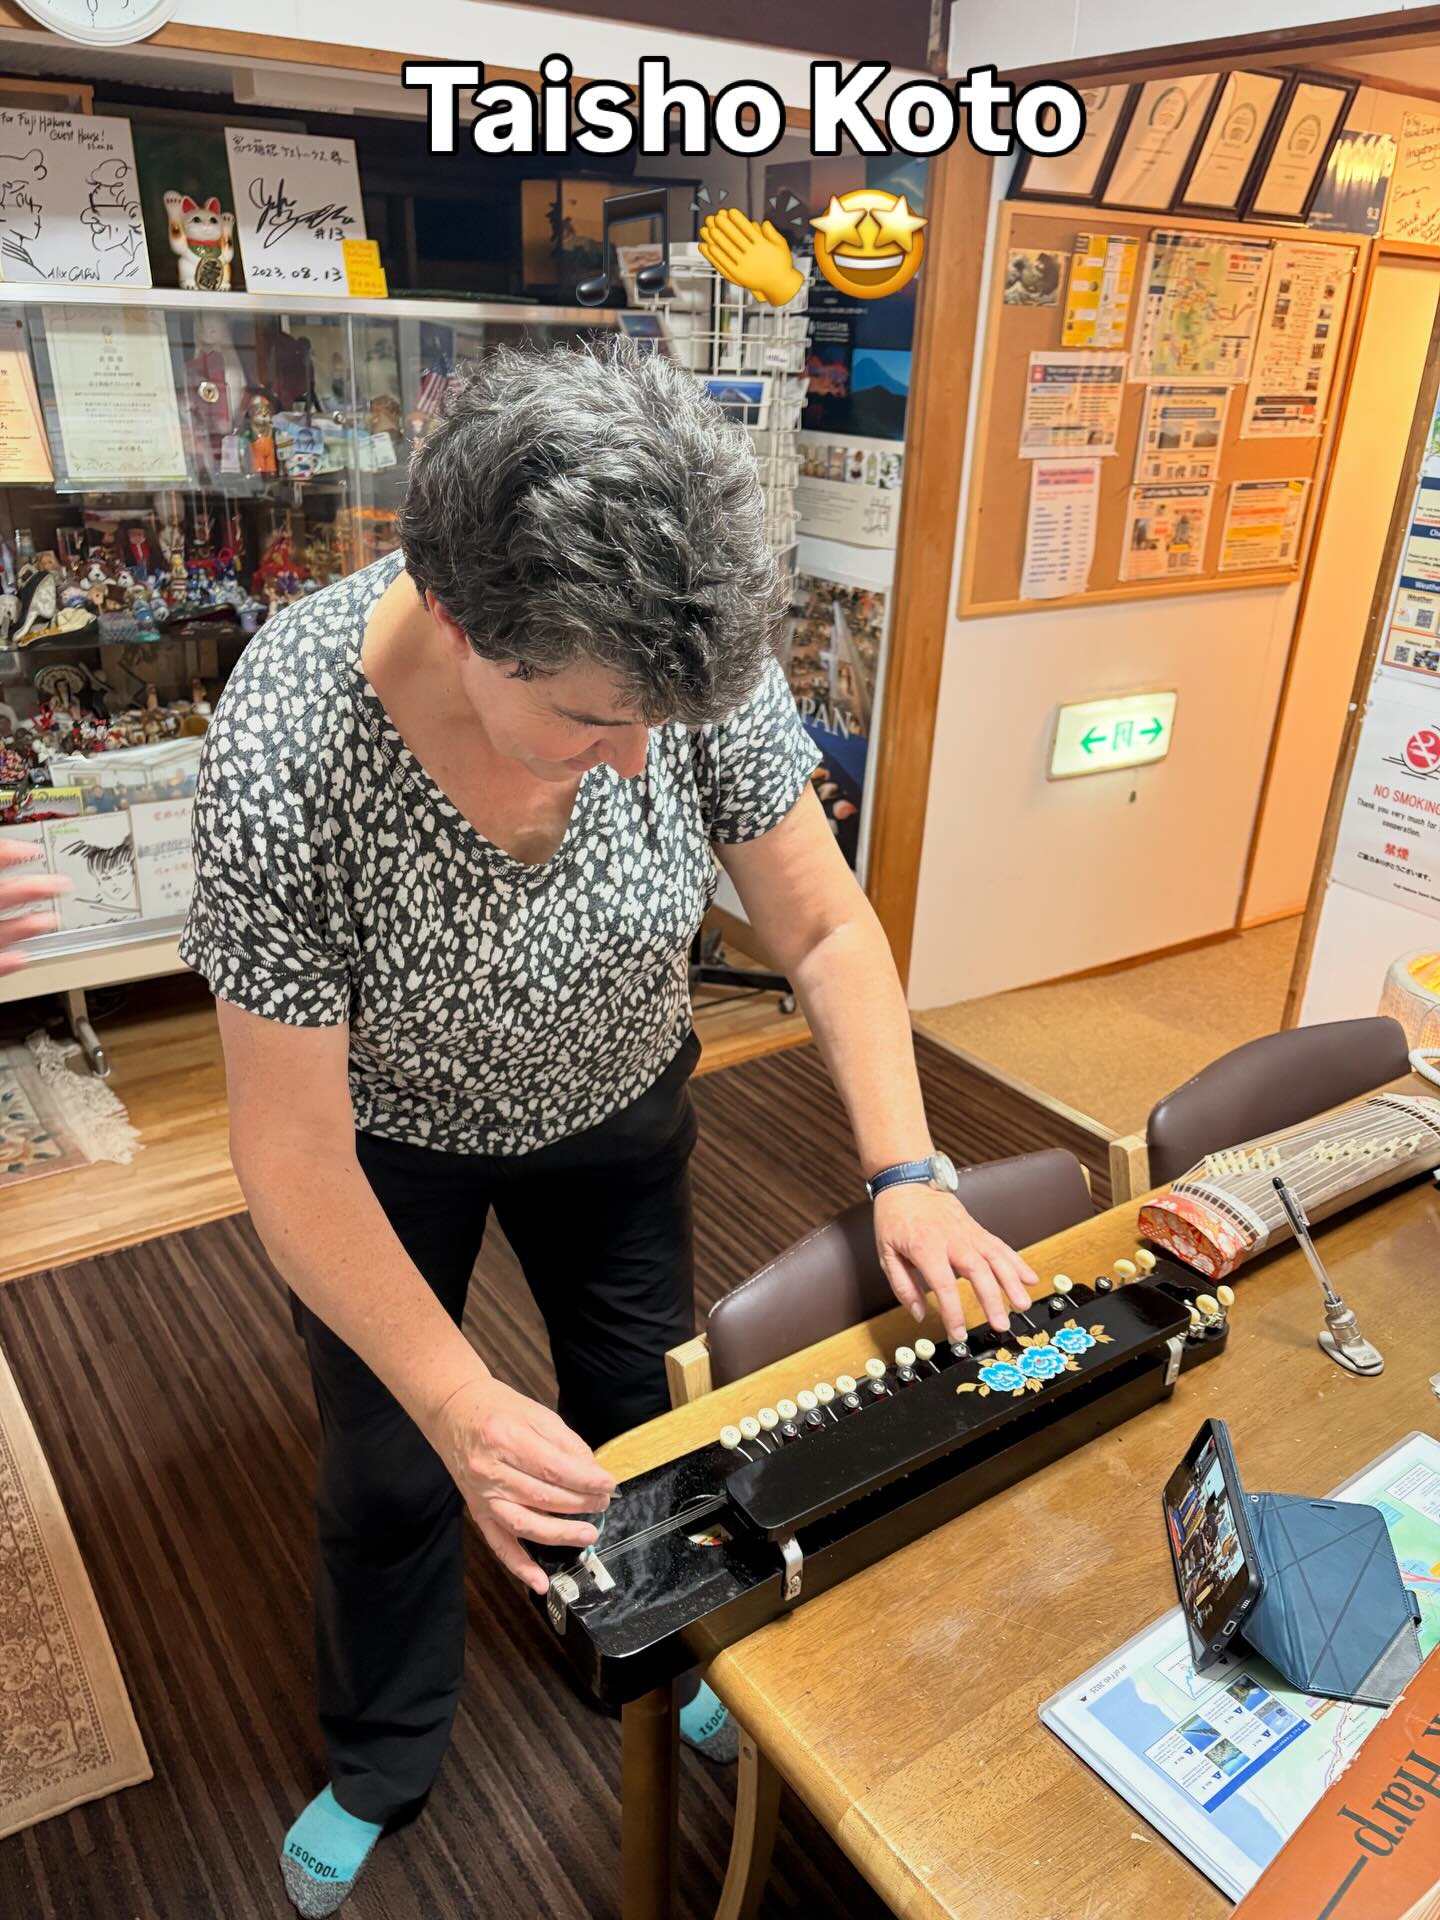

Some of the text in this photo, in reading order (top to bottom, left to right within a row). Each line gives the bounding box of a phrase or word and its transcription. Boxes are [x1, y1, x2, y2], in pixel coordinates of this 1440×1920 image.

[18, 112, 36, 136] Fuji
[39, 115, 72, 133] Hakone
[1374, 783, 1390, 799] NO
[1357, 797, 1375, 809] Thank
[1377, 805, 1389, 815] you
[1391, 809, 1405, 820] very
[1407, 815, 1425, 826] much
[1384, 842, 1409, 861] 禁煙
[289, 1843, 339, 1878] ISOCOOL
